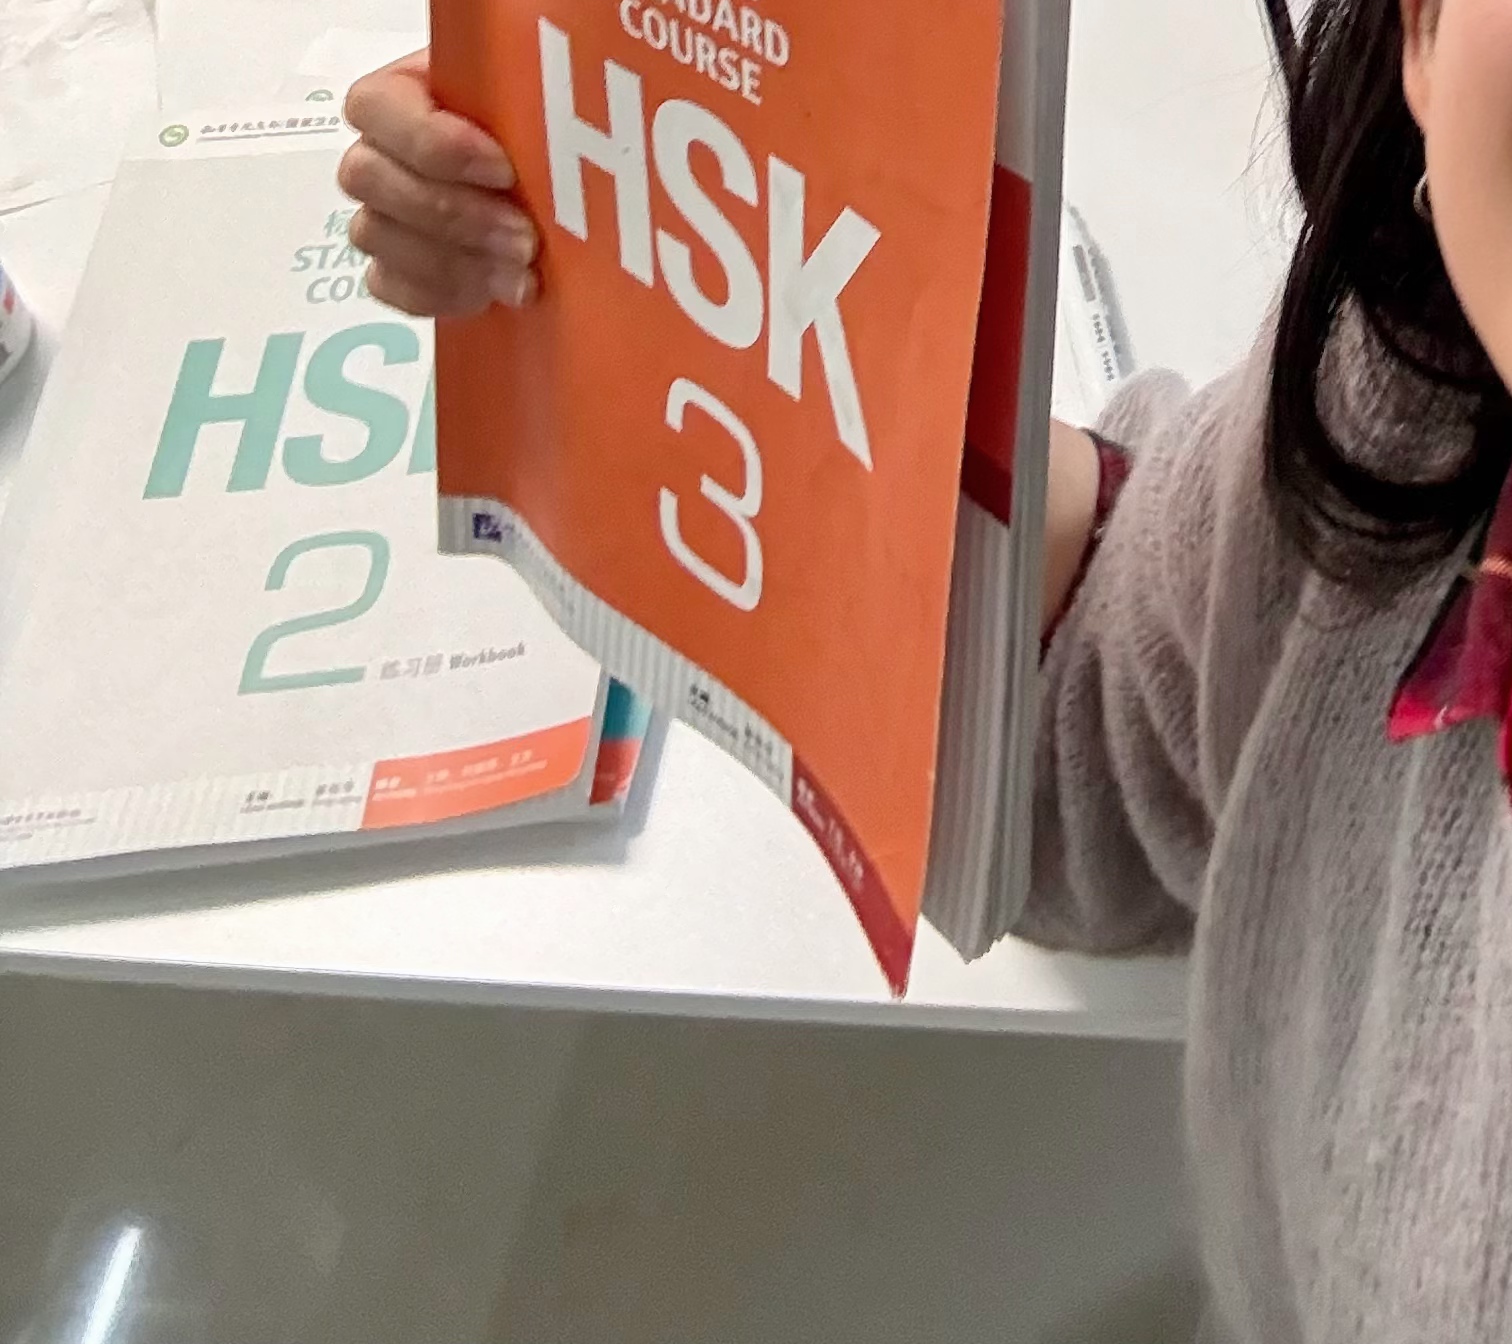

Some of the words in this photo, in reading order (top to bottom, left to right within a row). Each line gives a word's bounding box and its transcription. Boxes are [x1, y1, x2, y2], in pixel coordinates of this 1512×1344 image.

[538, 16, 881, 471] HSK
[142, 321, 437, 500] HS
[659, 377, 763, 612] 3
[238, 528, 392, 695] 2
